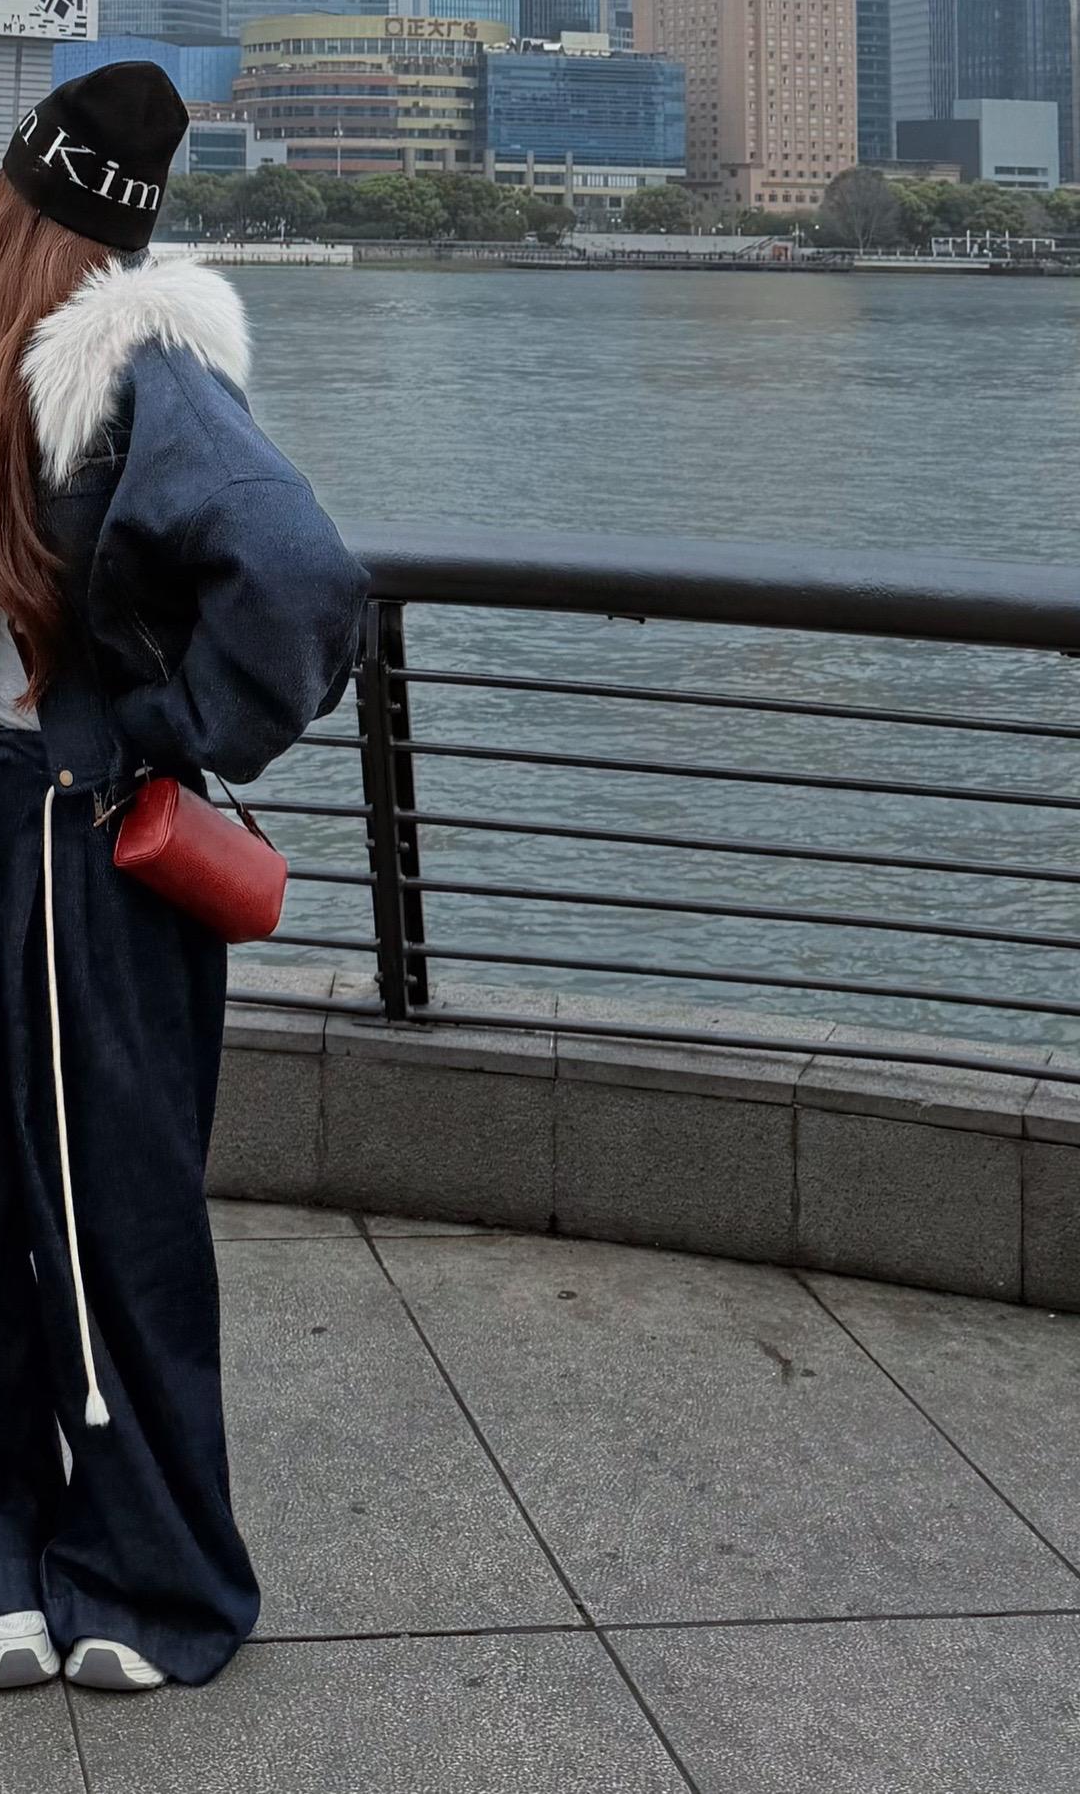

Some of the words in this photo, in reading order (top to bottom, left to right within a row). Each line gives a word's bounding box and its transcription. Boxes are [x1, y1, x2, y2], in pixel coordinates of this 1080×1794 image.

[406, 18, 478, 39] 正大广场
[38, 126, 161, 211] Kim
